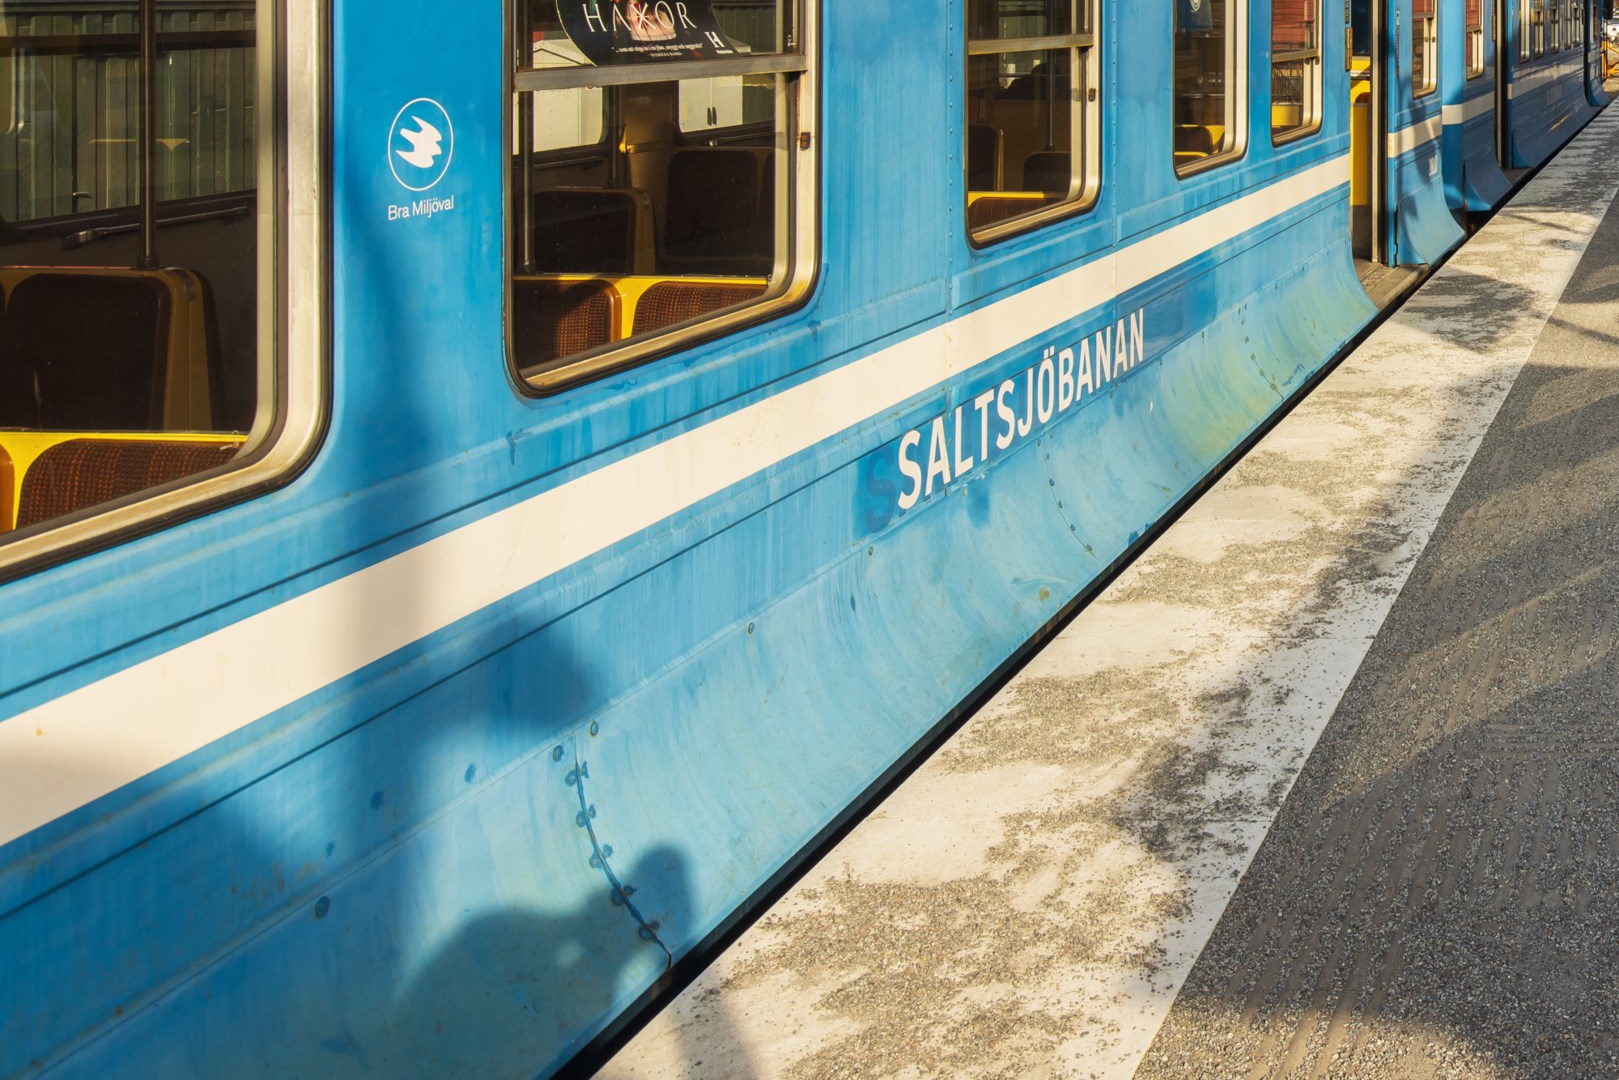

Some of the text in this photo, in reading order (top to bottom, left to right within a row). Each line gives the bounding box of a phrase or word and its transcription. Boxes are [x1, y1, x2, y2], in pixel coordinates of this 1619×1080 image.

[388, 194, 455, 221] Bra Miljöval
[897, 307, 1145, 510] SALTSJÖBANAN
